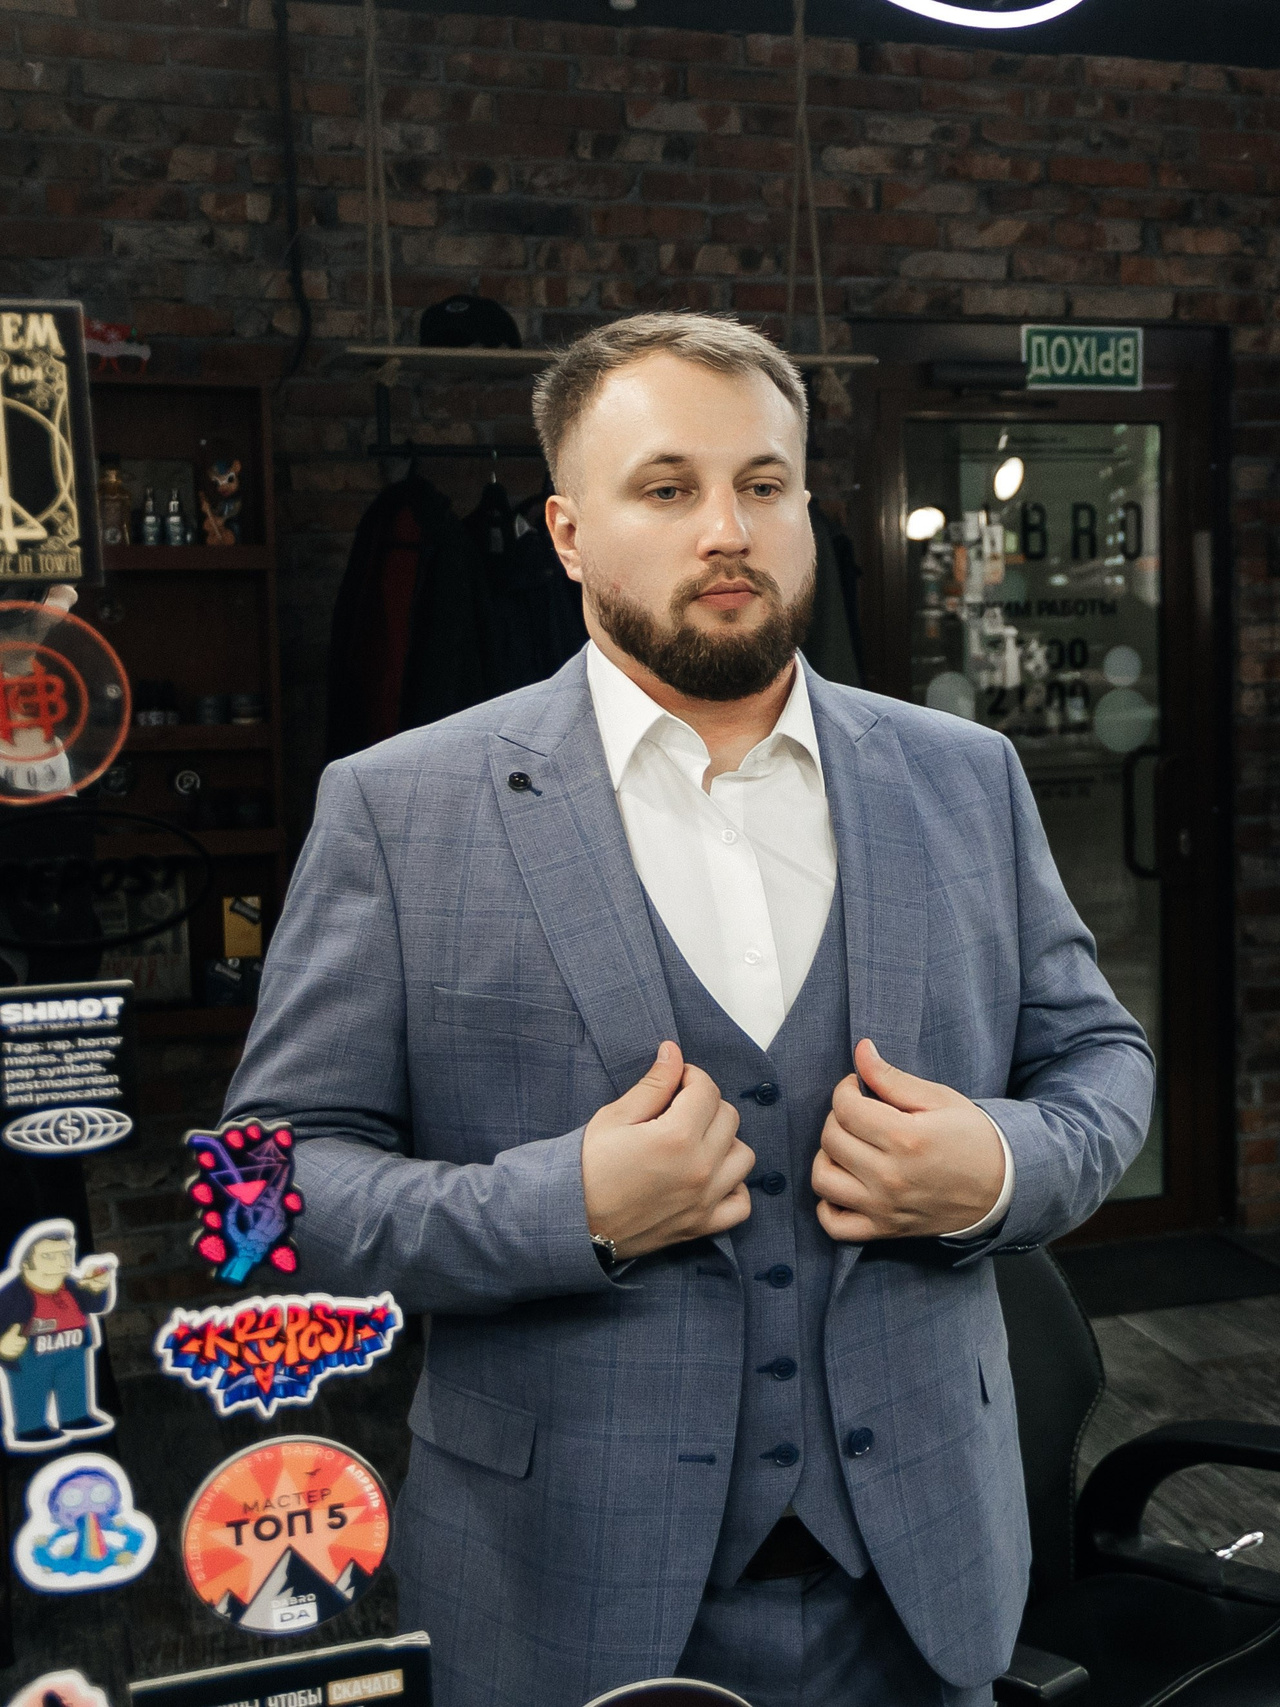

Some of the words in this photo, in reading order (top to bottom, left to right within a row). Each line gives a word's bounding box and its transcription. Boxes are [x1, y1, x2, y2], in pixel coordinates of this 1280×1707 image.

[0, 996, 125, 1024] SHMOT
[76, 1036, 124, 1047] horror
[5, 1068, 36, 1082] pop
[6, 1074, 120, 1094] postmodernism
[6, 1092, 34, 1106] and
[35, 1328, 83, 1353] BLATO
[243, 1488, 332, 1515] МАСТЕР
[226, 1509, 314, 1546] ТОП
[327, 1503, 347, 1530] 5
[279, 1609, 311, 1623] DA
[266, 1686, 324, 1707] ЧТОБЫ
[331, 1671, 401, 1702] СКАЧАТЬ
